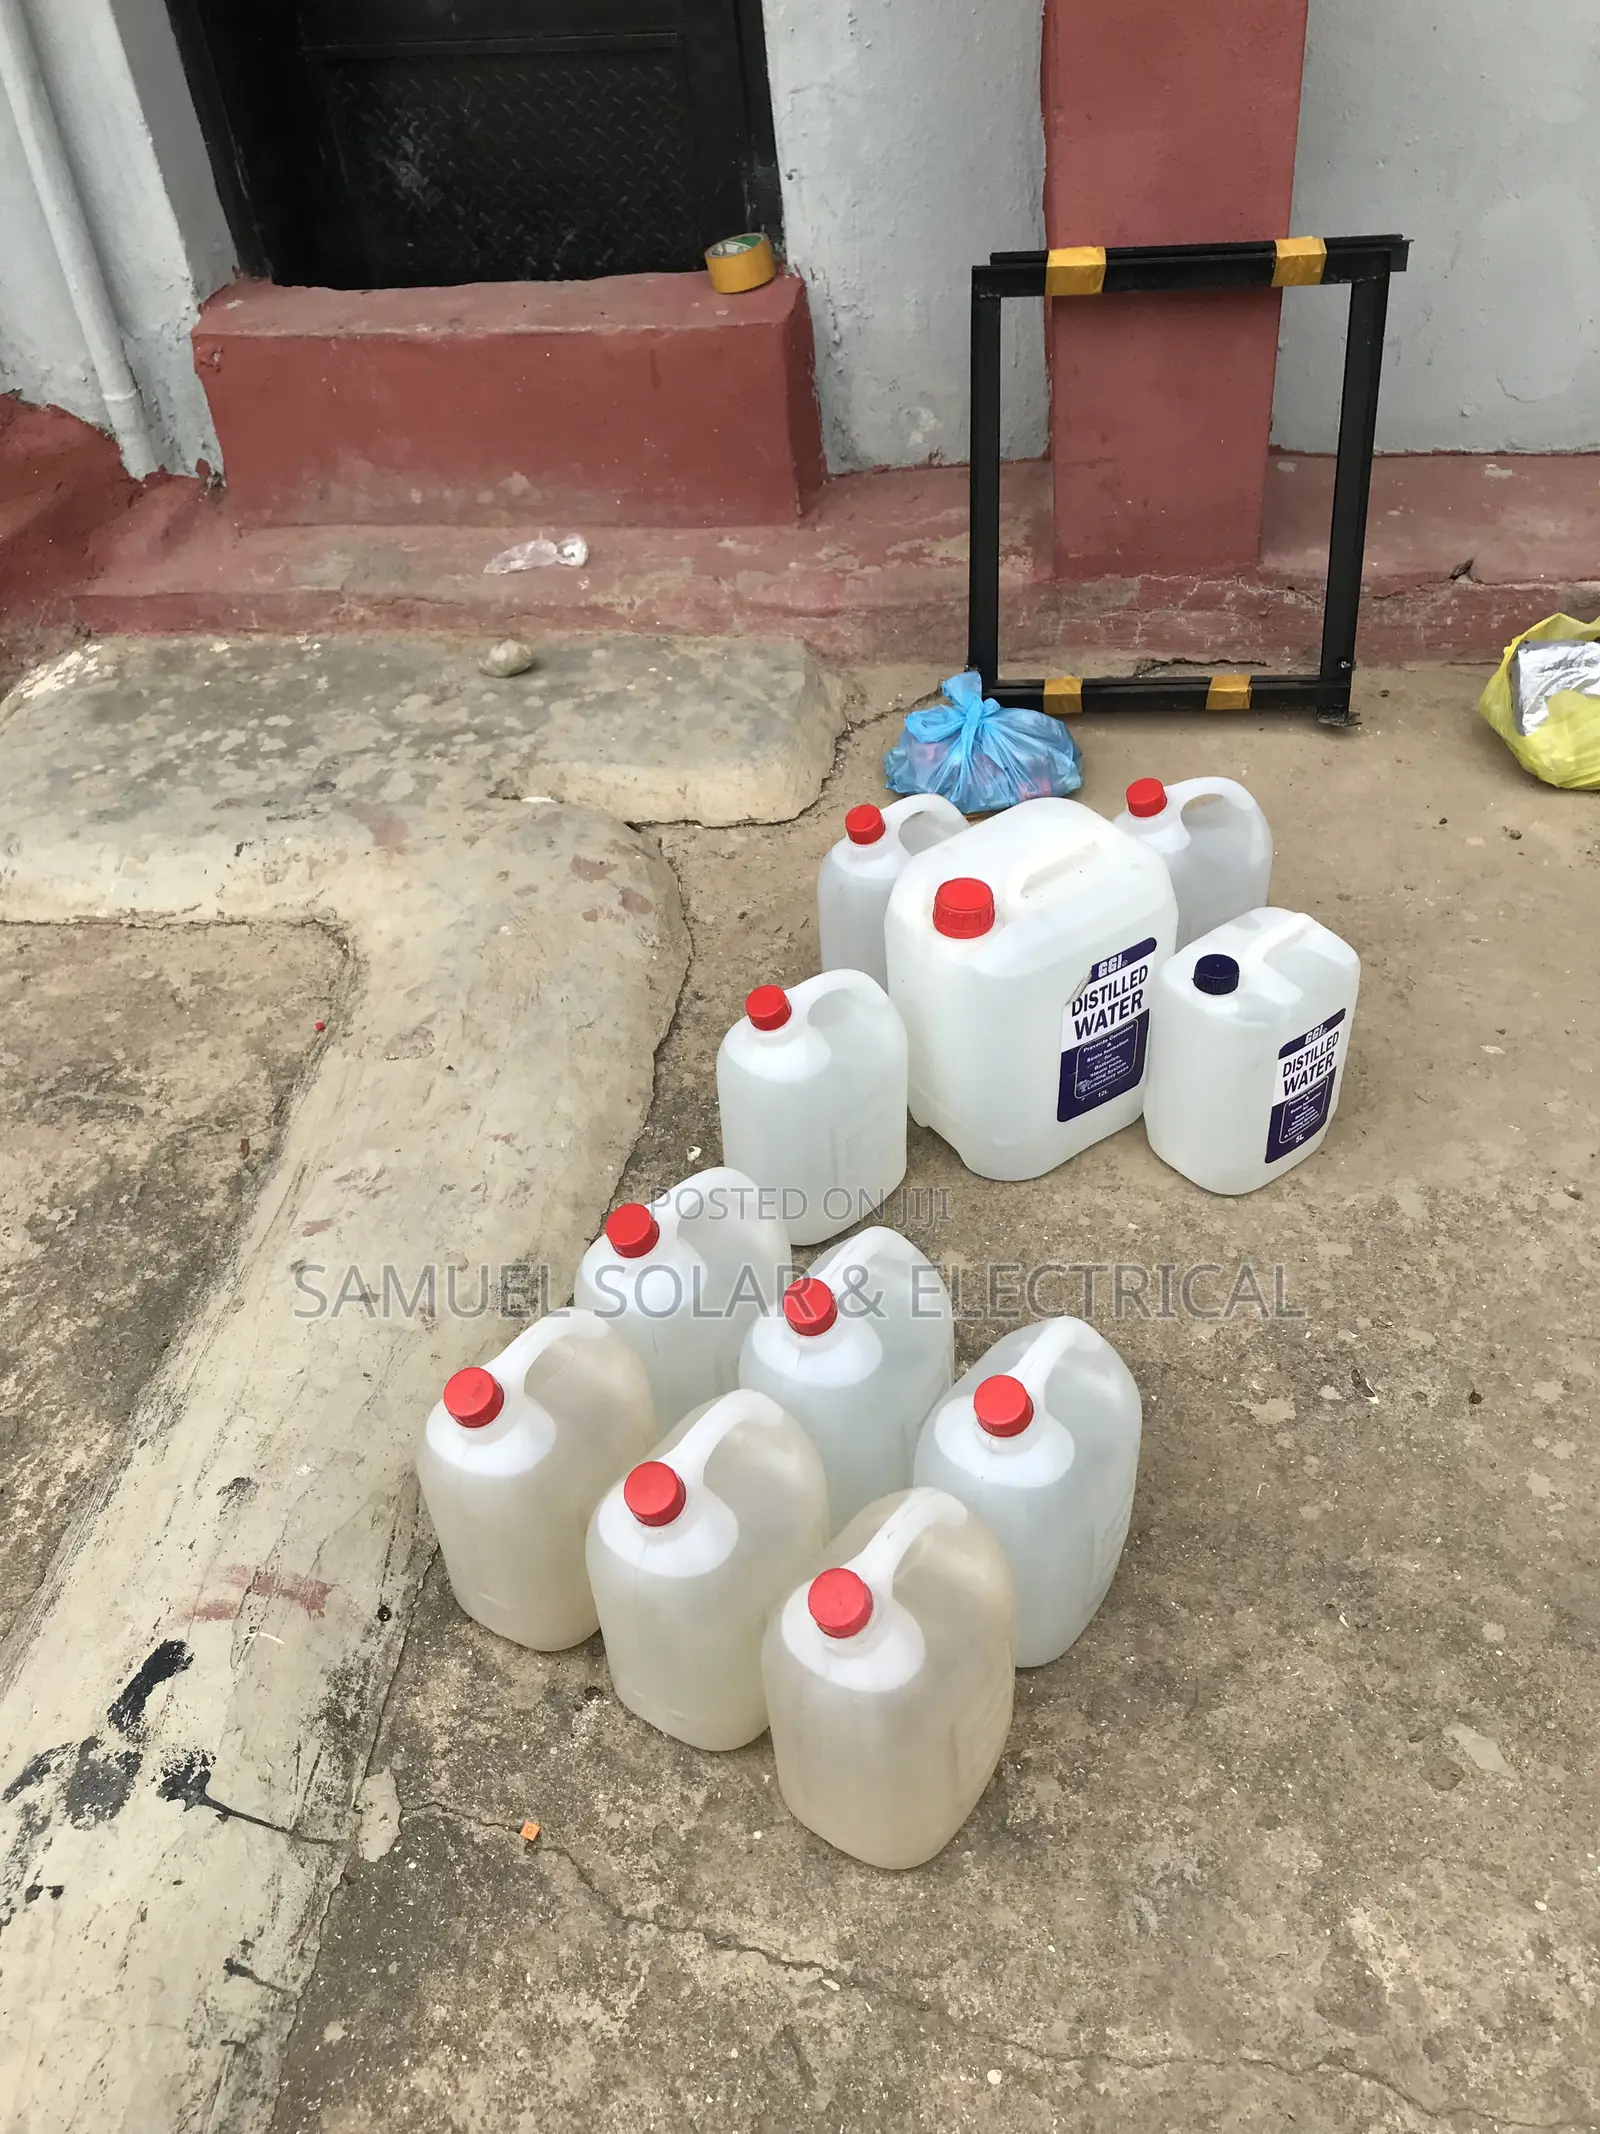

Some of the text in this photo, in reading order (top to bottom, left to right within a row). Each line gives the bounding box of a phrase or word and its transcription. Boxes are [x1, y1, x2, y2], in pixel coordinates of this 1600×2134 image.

[1072, 964, 1148, 1017] DISTILLED
[1074, 988, 1144, 1041] WATER
[1083, 1038, 1108, 1053] Prevents
[1086, 1051, 1103, 1063] Scale
[1282, 1030, 1339, 1078] DISTILLED
[1284, 1050, 1335, 1097] WATER
